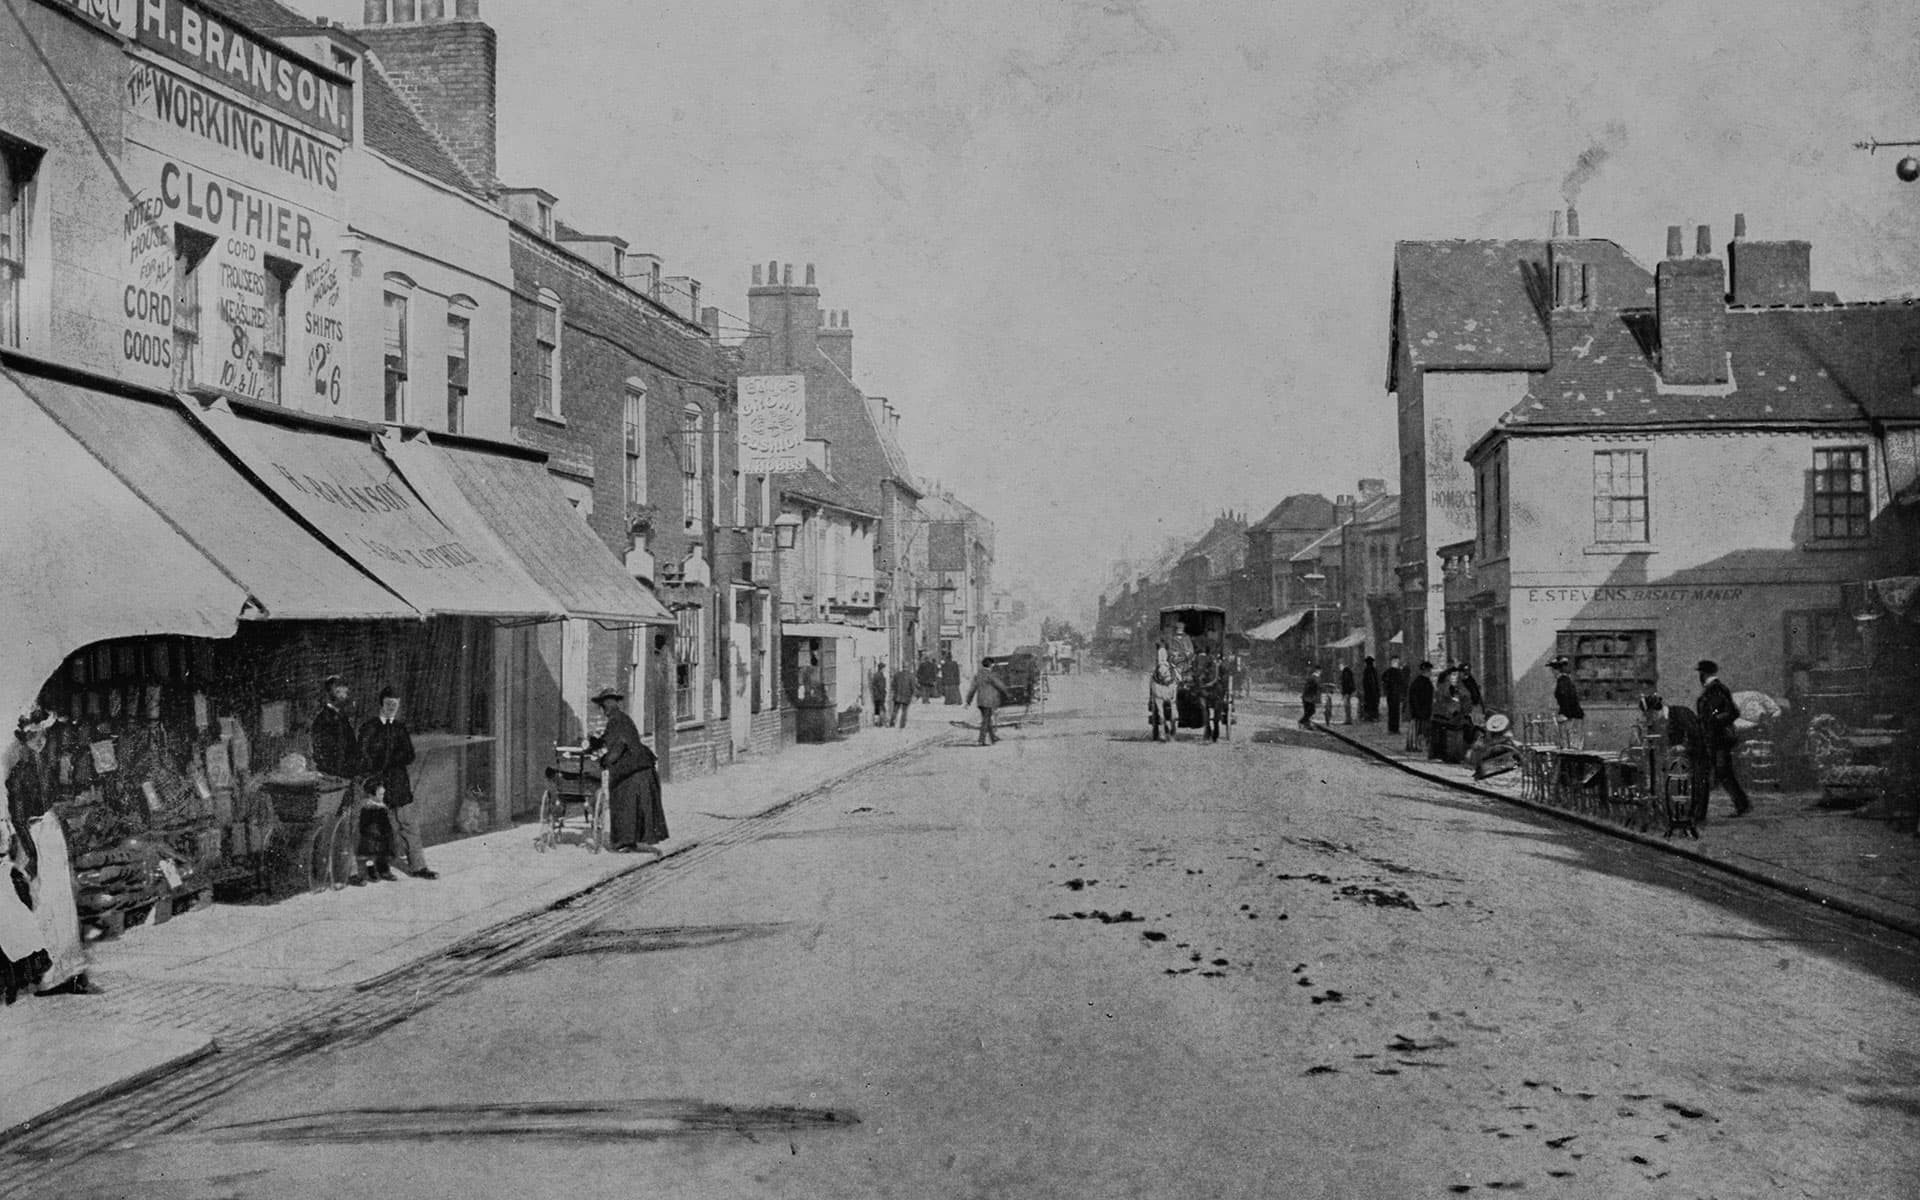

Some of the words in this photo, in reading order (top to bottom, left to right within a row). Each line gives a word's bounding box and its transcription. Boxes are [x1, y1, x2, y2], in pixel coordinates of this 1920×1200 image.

[127, 64, 151, 107] THE
[151, 68, 264, 161] WORKING
[269, 120, 339, 192] MANS
[123, 197, 163, 242] NOTED
[130, 224, 169, 264] HOUSE
[227, 240, 257, 262] CORD
[220, 262, 265, 297] TROUSERS
[124, 284, 172, 327] CORD
[219, 296, 266, 329] MEASURE
[305, 311, 344, 342] SHIRTS
[124, 328, 172, 370] GOODS
